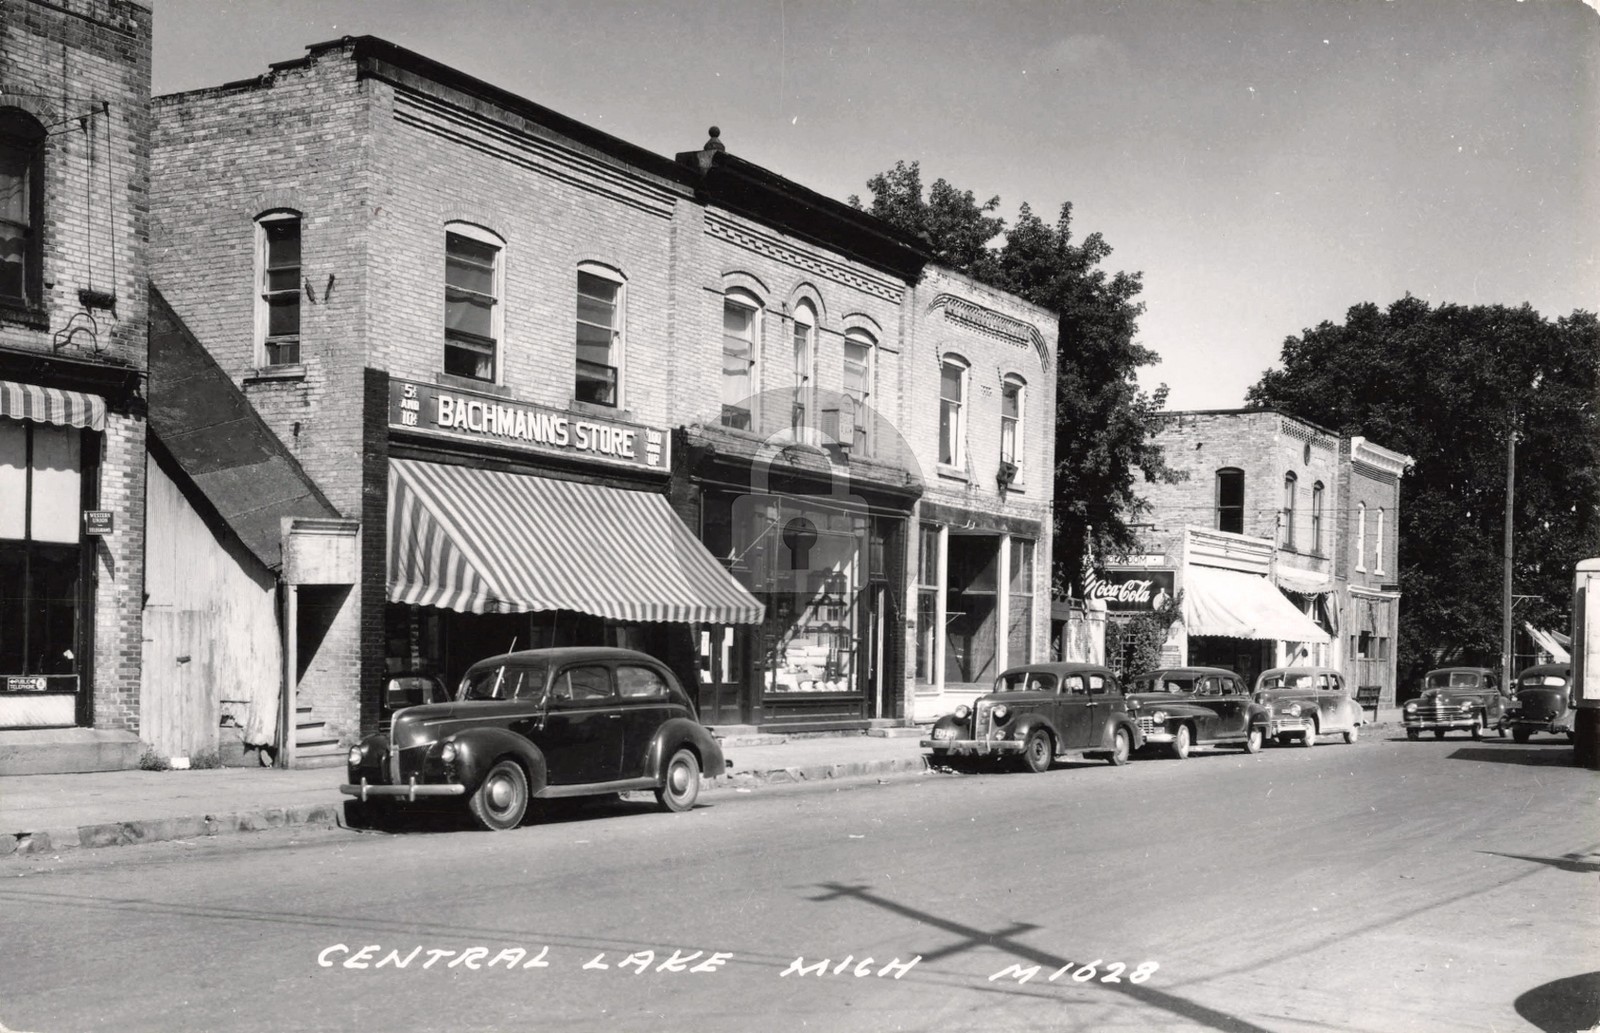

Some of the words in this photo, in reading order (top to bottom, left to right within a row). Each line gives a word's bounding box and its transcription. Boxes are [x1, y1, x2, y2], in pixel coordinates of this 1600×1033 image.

[400, 399, 420, 411] AND
[438, 395, 569, 446] BACHMANN'S
[576, 421, 635, 457] STORE
[647, 453, 660, 466] UP
[1091, 579, 1153, 602] Coca-Cola
